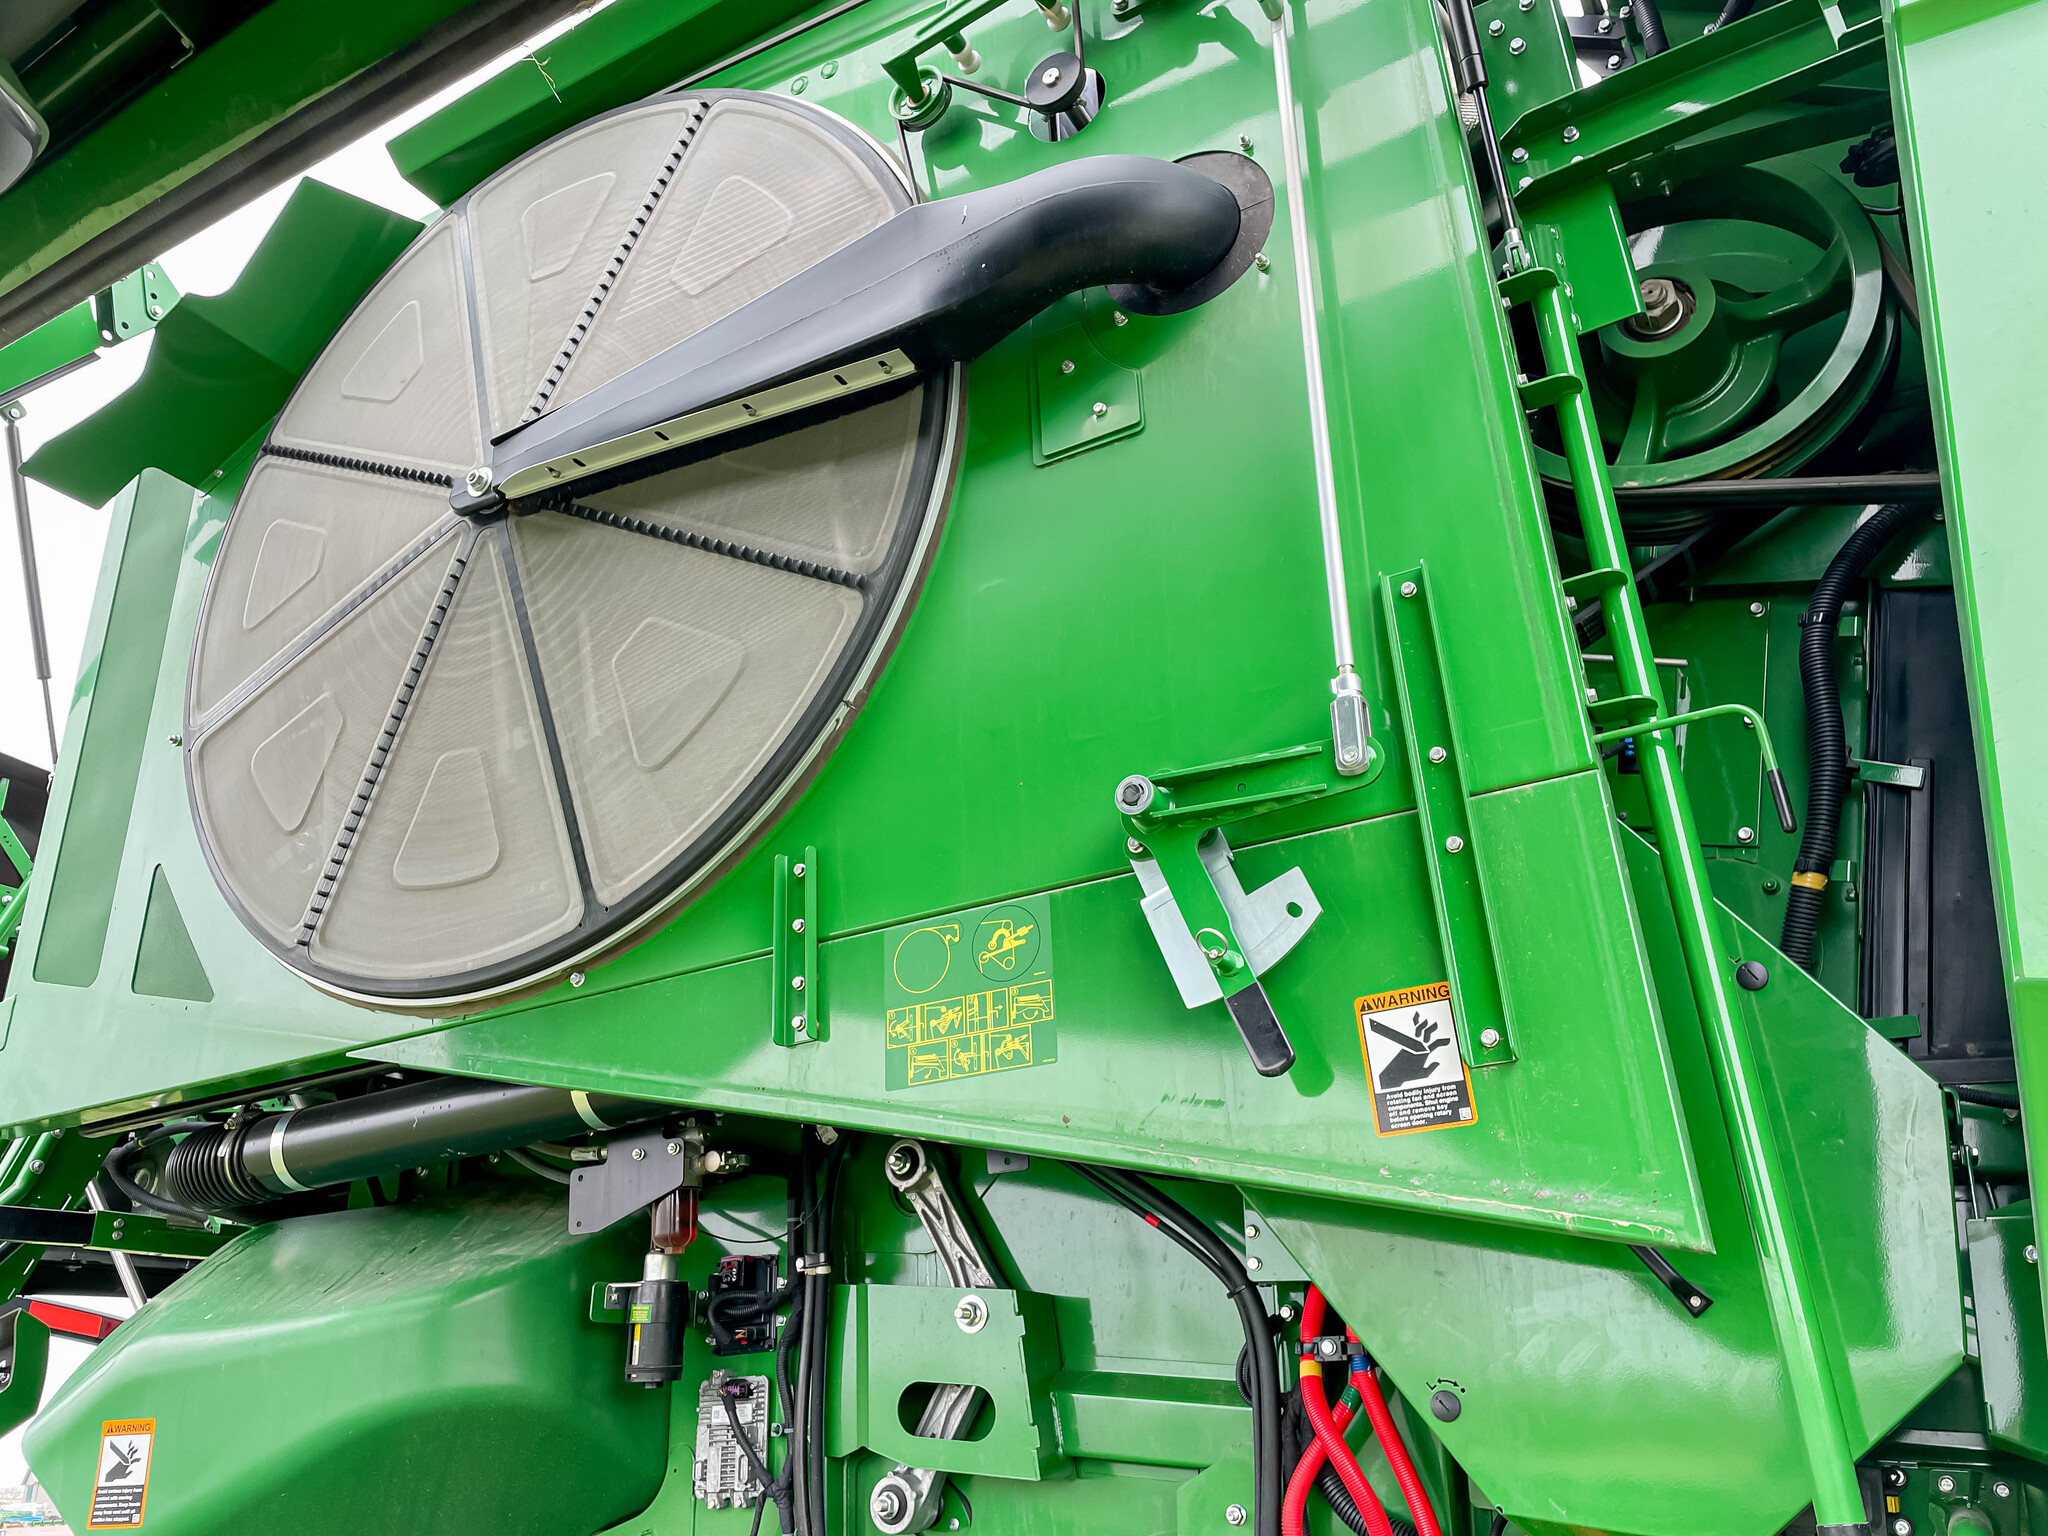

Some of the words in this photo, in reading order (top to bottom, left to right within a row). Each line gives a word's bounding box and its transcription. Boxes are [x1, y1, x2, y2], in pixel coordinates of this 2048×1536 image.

[1372, 985, 1450, 1009] WARNING
[1404, 1089, 1422, 1098] bodily
[1424, 1086, 1440, 1094] injury
[1388, 1102, 1424, 1111] components.
[1410, 1112, 1433, 1122] opening
[114, 1423, 150, 1432] WARNING
